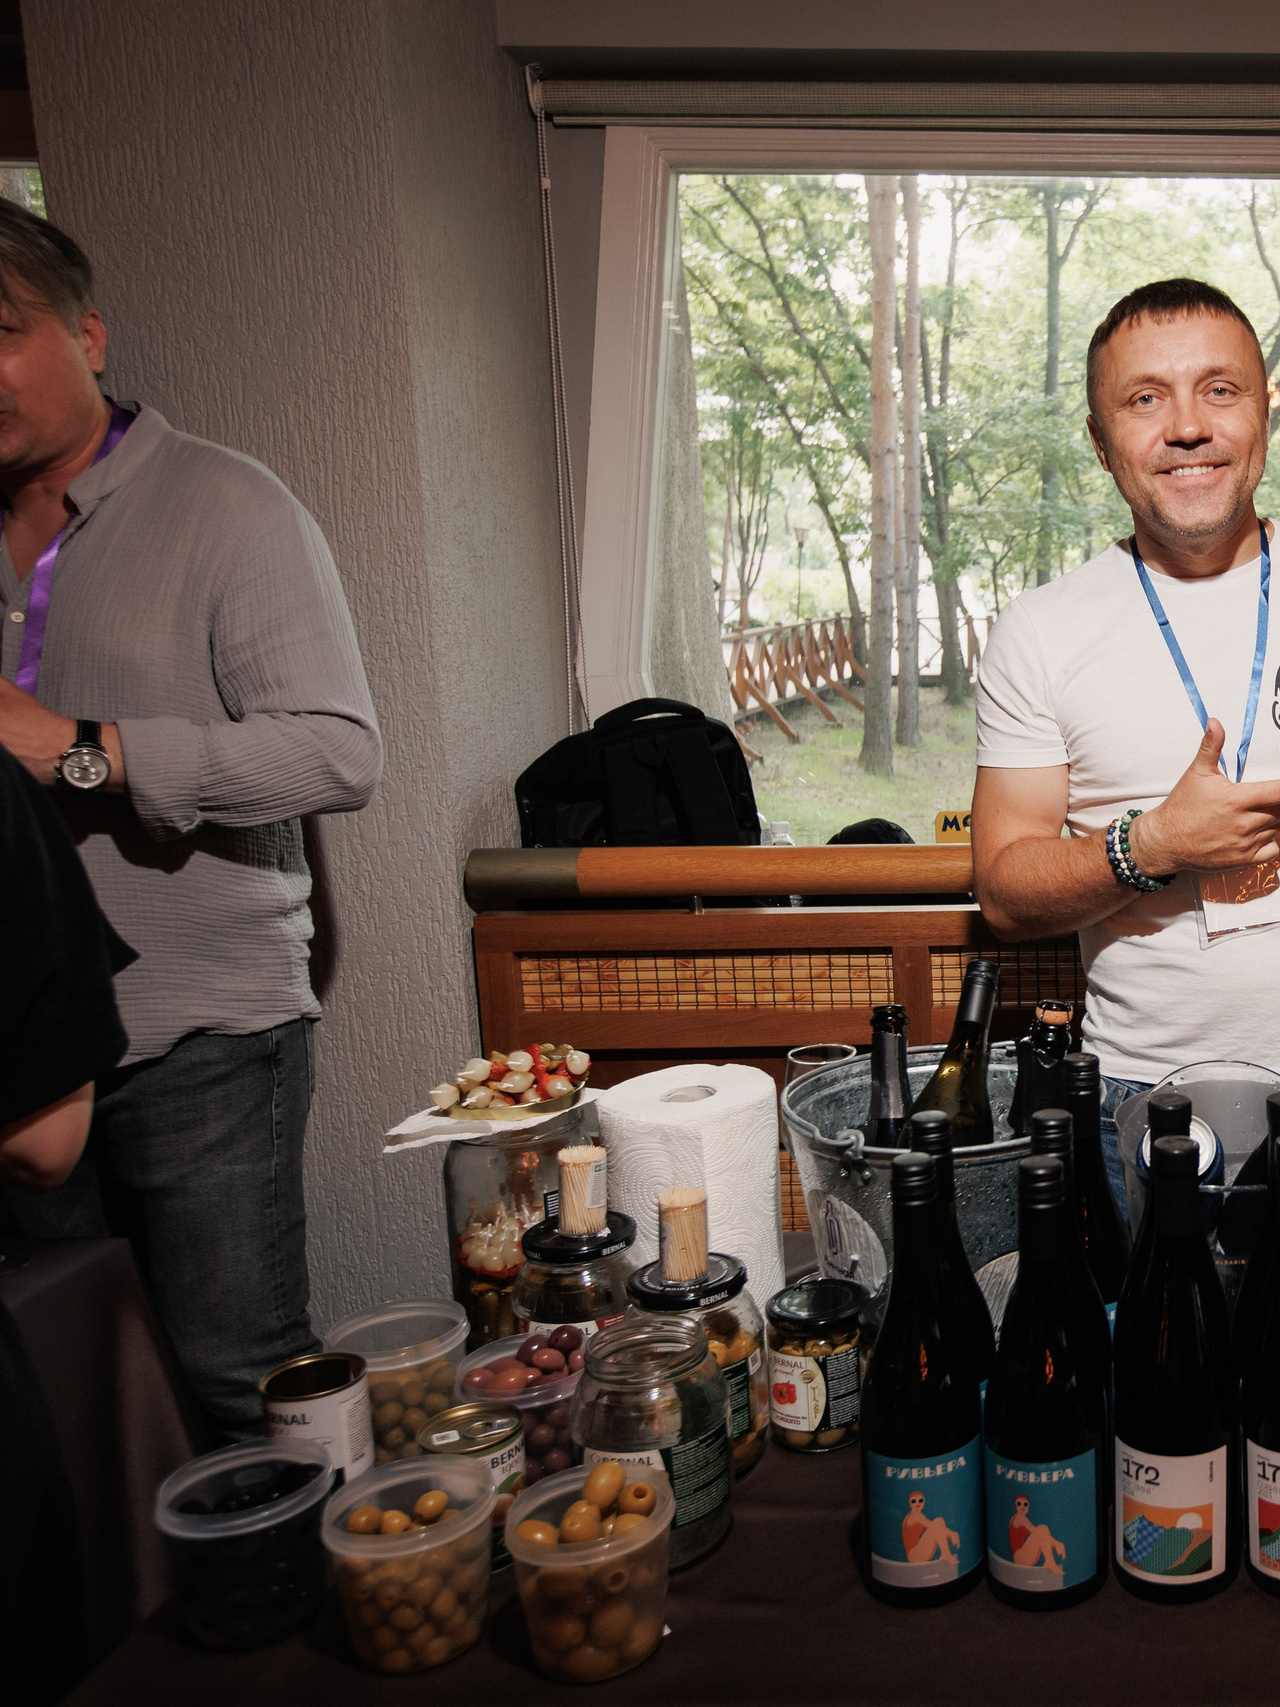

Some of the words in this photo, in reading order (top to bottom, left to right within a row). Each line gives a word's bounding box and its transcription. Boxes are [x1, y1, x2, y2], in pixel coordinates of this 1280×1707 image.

[602, 1240, 627, 1256] BERNAL
[699, 1290, 730, 1307] BERNAL
[773, 1355, 805, 1369] BERNAL
[269, 1412, 311, 1425] RNAL
[491, 1438, 525, 1469] BERNA
[886, 1455, 967, 1480] РИВЬЕРА
[996, 1463, 1075, 1484] РИВЬЕРА
[1122, 1457, 1160, 1486] 172
